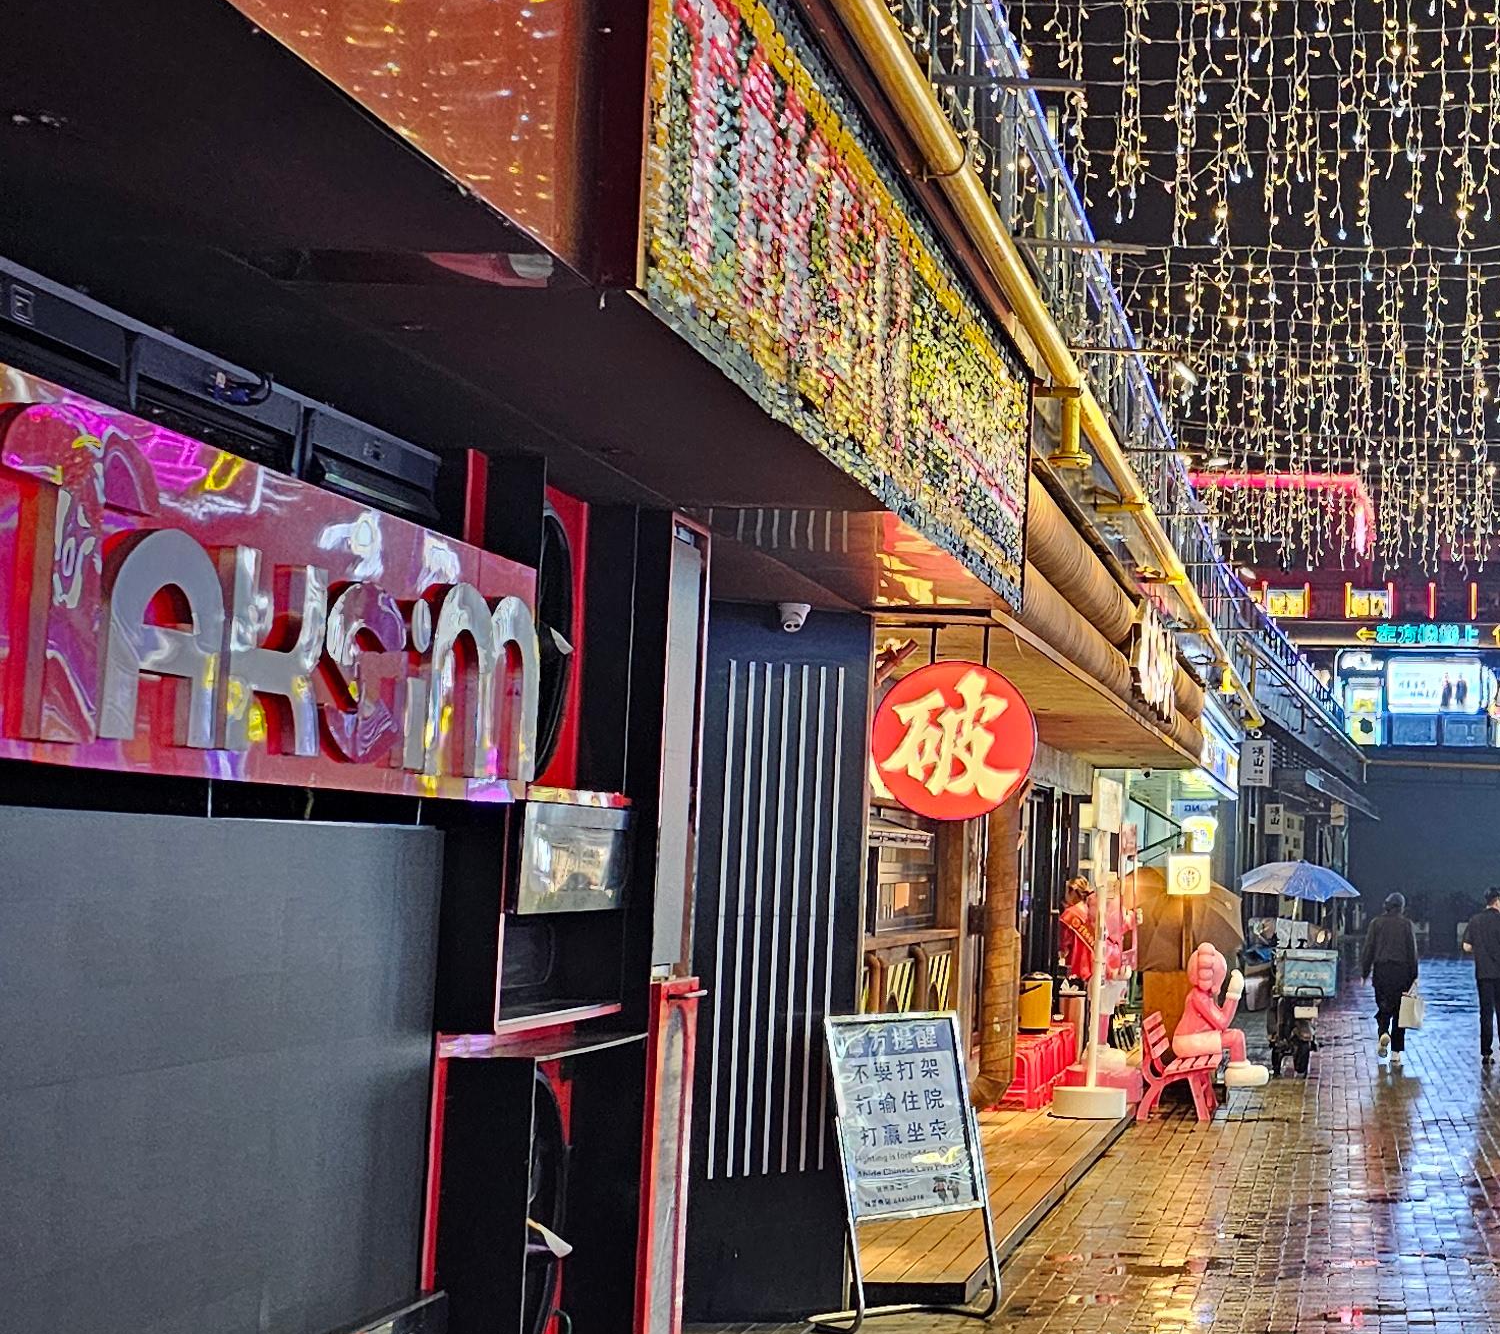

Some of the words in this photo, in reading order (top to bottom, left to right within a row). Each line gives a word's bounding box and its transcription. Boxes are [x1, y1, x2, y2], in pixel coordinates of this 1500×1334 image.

[881, 670, 1022, 805] 破
[851, 1058, 940, 1084] 不要打架
[855, 1088, 945, 1116] 打输住院
[861, 1118, 948, 1148] 打赢坐牢
